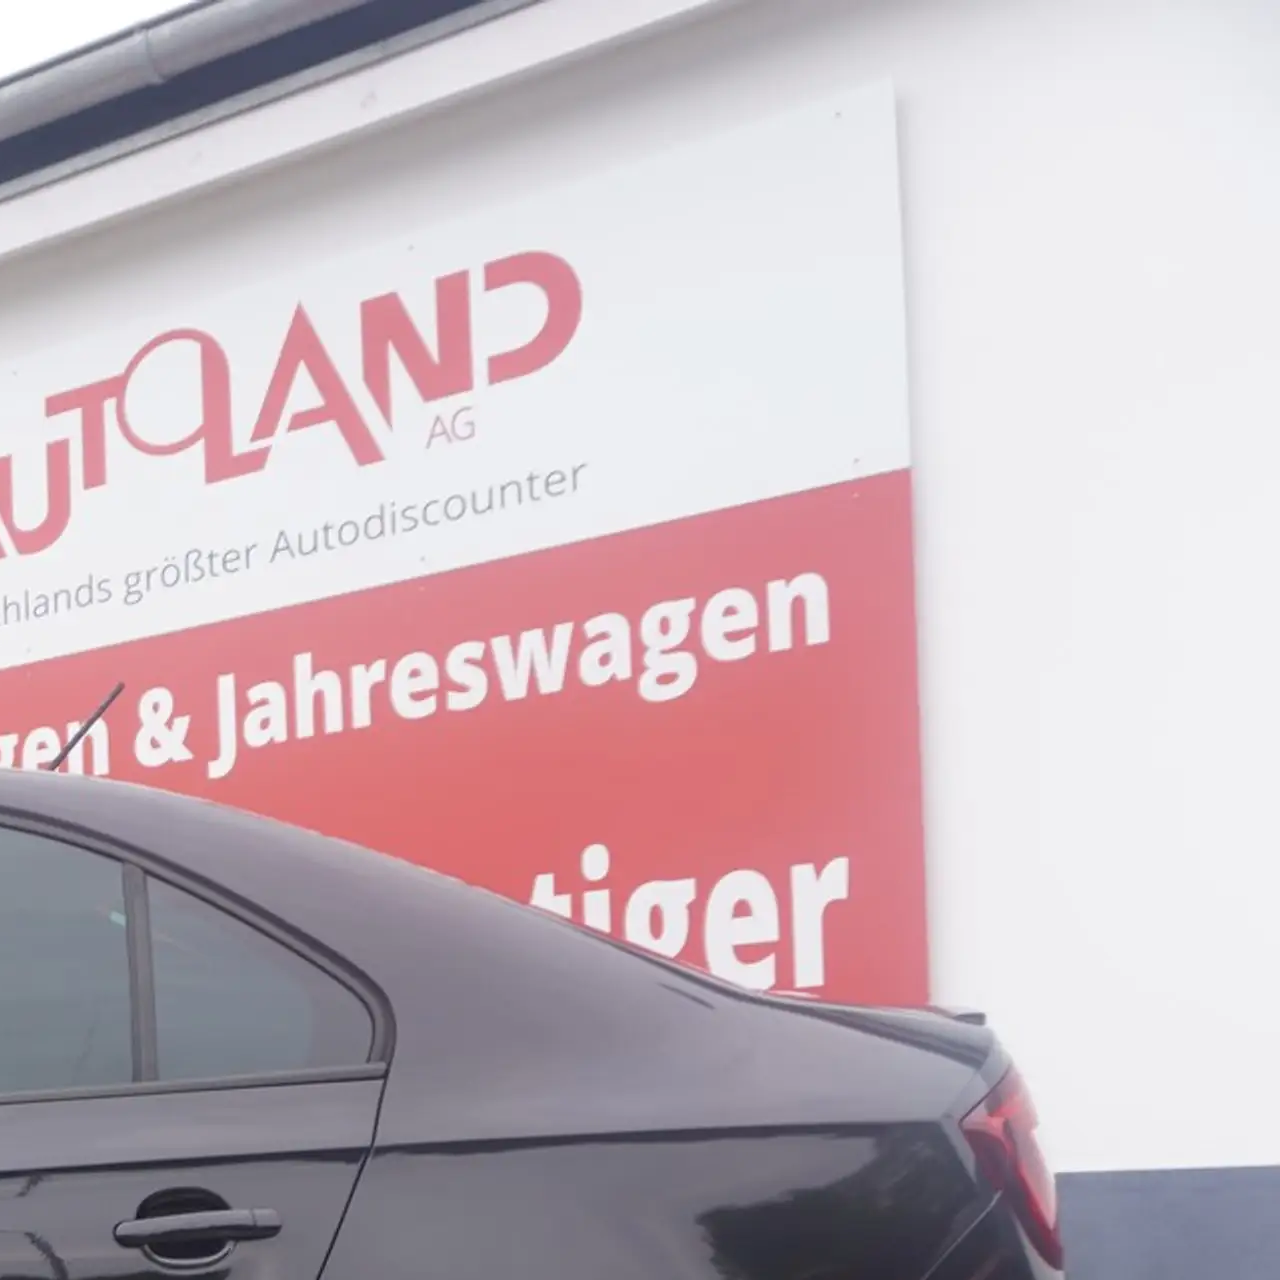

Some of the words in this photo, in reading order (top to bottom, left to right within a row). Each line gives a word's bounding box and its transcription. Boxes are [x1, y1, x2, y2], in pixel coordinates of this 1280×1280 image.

[425, 405, 477, 450] AG
[122, 542, 258, 606] größter
[268, 461, 588, 563] Autodiscounter
[133, 686, 194, 768] &
[207, 571, 830, 779] Jahreswagen
